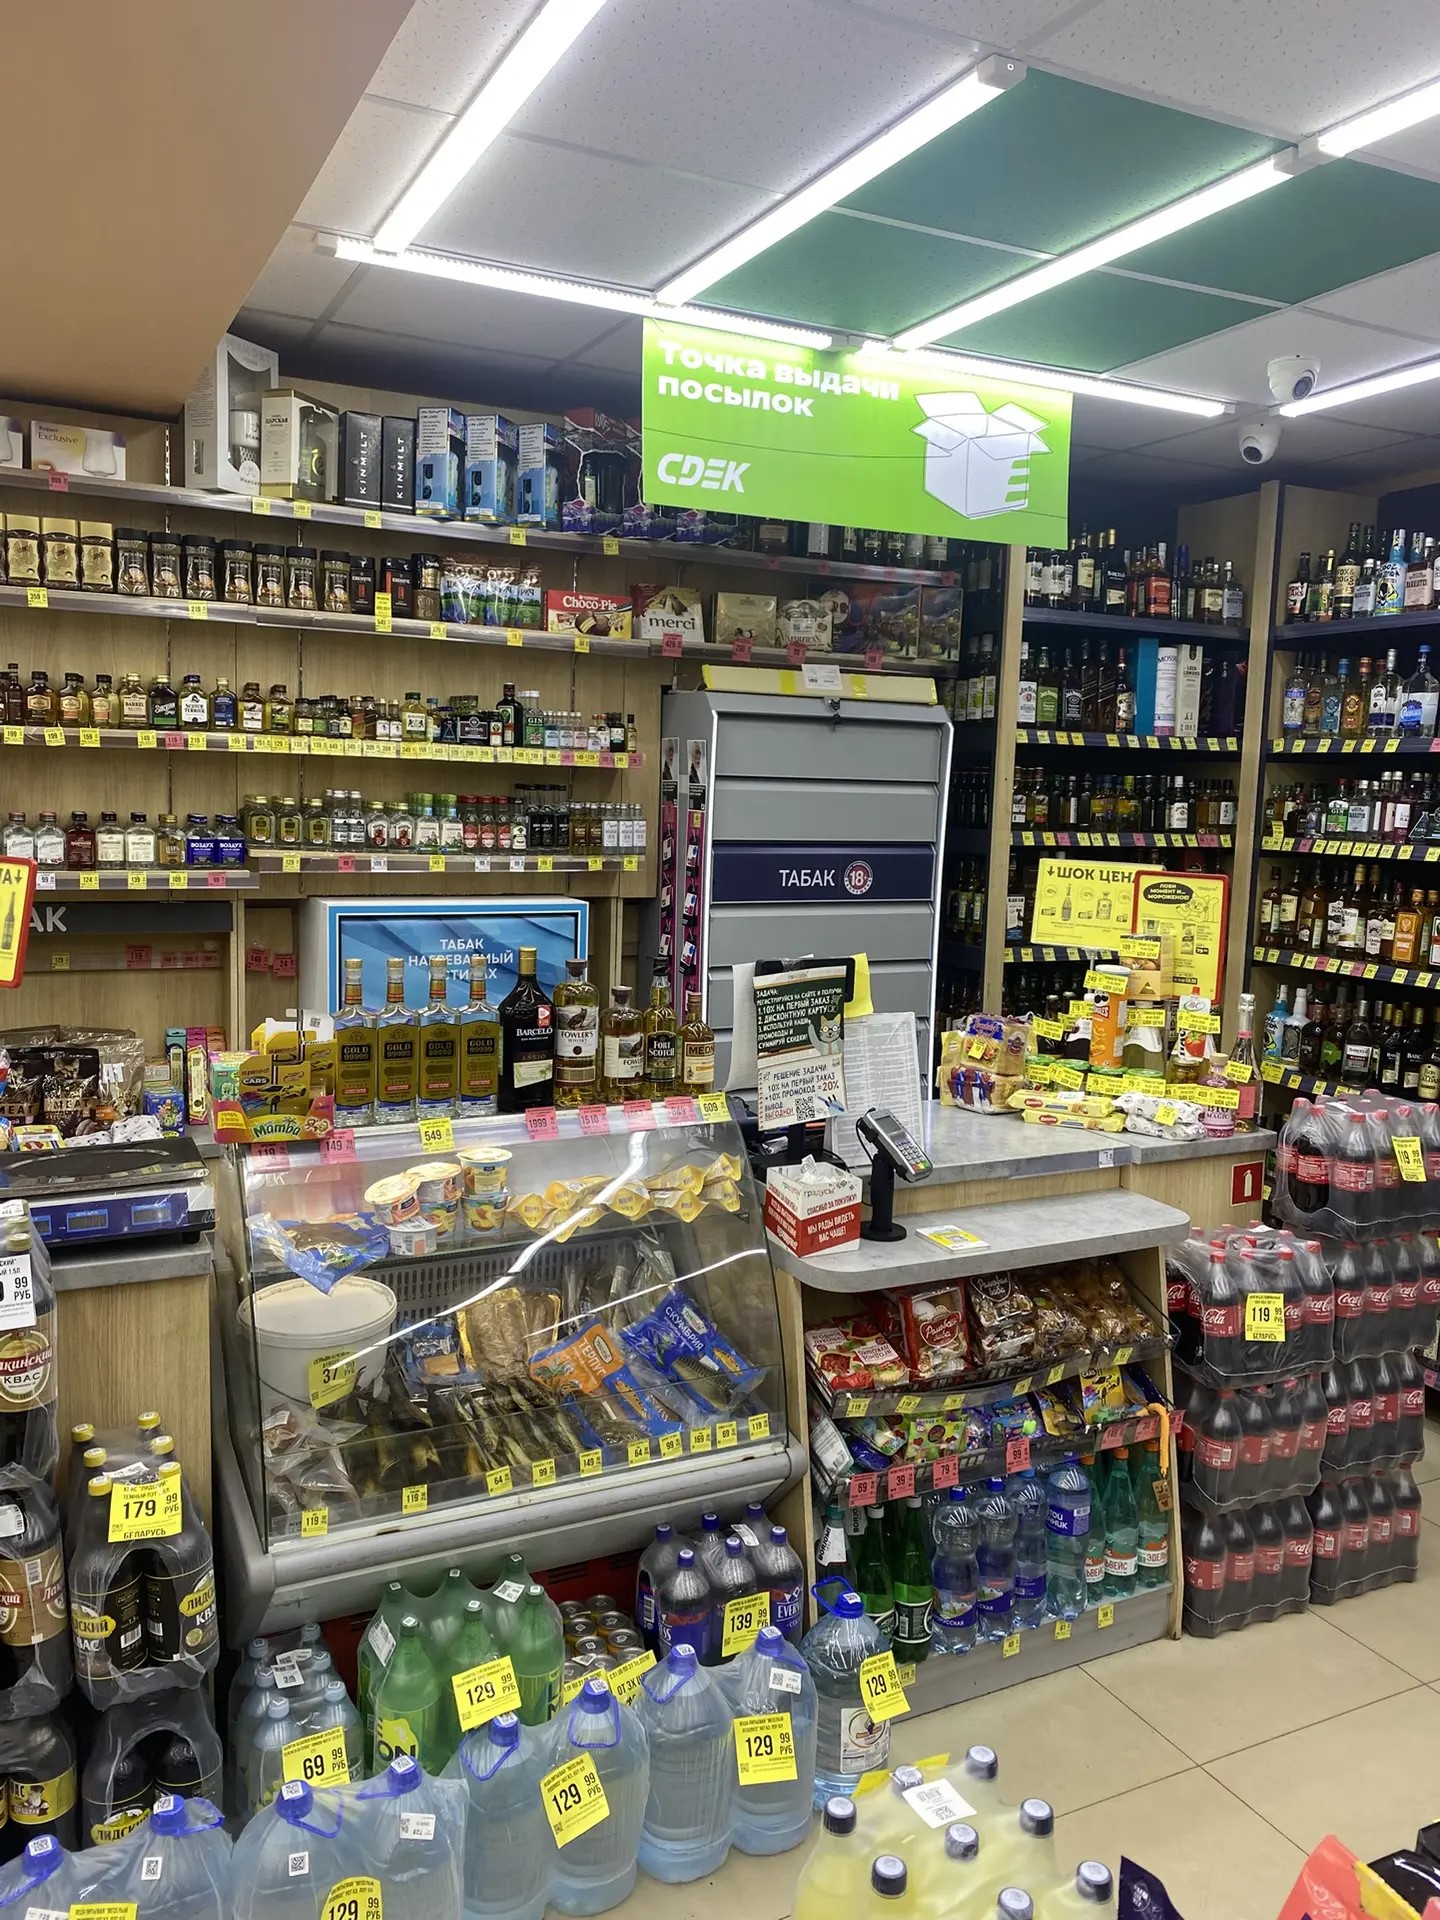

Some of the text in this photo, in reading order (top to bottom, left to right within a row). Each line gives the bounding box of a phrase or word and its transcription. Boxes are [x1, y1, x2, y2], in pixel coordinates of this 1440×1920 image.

[658, 341, 899, 402] Точка выдачи
[658, 373, 815, 418] посылок
[265, 416, 288, 425] ЦАРСКАЯ
[38, 431, 79, 445] Exclusive
[657, 453, 751, 494] CDEK
[563, 596, 617, 610] Choco-Pie
[649, 616, 696, 630] merci
[527, 716, 543, 725] GIN
[779, 869, 836, 887] ТАБАК
[1056, 866, 1094, 880] ШОК
[41, 876, 49, 884] 99
[440, 938, 484, 950] ТАБАК
[801, 990, 816, 999] САЙТЕ
[776, 1004, 785, 1012] НА
[786, 999, 810, 1010] ПЕРВЫЙ
[811, 997, 830, 1006] ЗАКАЗ
[763, 1009, 806, 1024] ДИСКОНТНУЮ
[807, 1006, 828, 1016] КАРТУ
[516, 1027, 553, 1037] BARCELÓ
[561, 1031, 594, 1039] FOWLER'S
[758, 1030, 788, 1041] ПРОМОКОДЫ
[387, 1043, 411, 1051] GOLD
[469, 1039, 492, 1047] GOLD
[653, 1040, 671, 1049] FORT
[344, 1045, 369, 1054] GOLD
[649, 1049, 675, 1057] SCOTCH
[773, 1068, 800, 1081] РЕШЕНИЕ
[243, 1076, 267, 1085] CARS
[768, 1072, 836, 1092] 10% НА ПЕРВЫЙ ЗАКАЗ
[782, 1086, 816, 1099] ПРОМОКОД
[704, 1102, 719, 1113] 609
[528, 1118, 547, 1128] 1999
[581, 1115, 599, 1124] 1510
[252, 1122, 301, 1138] Mamba
[424, 1130, 443, 1141] 549
[325, 1139, 343, 1151] 149
[1398, 1149, 1420, 1165] 119 99
[804, 1188, 835, 1198] градусы
[806, 1204, 827, 1216] СПАСИБО
[834, 1194, 857, 1207] ПОКУПКУ!
[807, 1212, 855, 1235] МЫ РАДЫ ВИДЕТЬ
[819, 1226, 847, 1243] ВАС ЧАЩЕ!
[15, 1276, 28, 1288] 99
[14, 1288, 31, 1301] РУБ
[1252, 1307, 1282, 1322] 119 99
[665, 1306, 704, 1351] СКУМБРИЯ
[1253, 1332, 1277, 1341] БЕЛАРУСЬ
[579, 1338, 607, 1376] ТЕРПУГ
[4, 1371, 41, 1384] КВАС
[1327, 1407, 1346, 1423] Cola
[751, 1421, 763, 1430] 119
[694, 1434, 706, 1444] 169
[722, 1429, 730, 1438] 69
[666, 1441, 675, 1450] 99
[634, 1448, 643, 1457] 64
[1012, 1449, 1022, 1460] 99
[583, 1457, 594, 1467] 149
[539, 1467, 548, 1477] 99
[940, 1464, 950, 1475] 79
[493, 1476, 503, 1485] 64
[896, 1475, 906, 1486] 39
[857, 1482, 868, 1493] 69
[406, 1494, 419, 1503] 119
[123, 1493, 178, 1519] 179 99
[164, 1503, 180, 1514] РУБ
[305, 1516, 319, 1526] 119
[123, 1528, 166, 1539] БЕЛАРУСЬ
[818, 1527, 831, 1561] BORJOMI
[730, 1608, 767, 1632] 139 99
[757, 1618, 769, 1628] РУБ
[502, 1683, 516, 1694] РУБ
[617, 1679, 637, 1696] ОТ 3Х
[866, 1669, 897, 1698] 129 99
[465, 1681, 495, 1706] 129
[501, 1673, 512, 1684] 99
[745, 1732, 790, 1758] 129 99
[779, 1744, 793, 1755] РУБ
[303, 1747, 343, 1780] 69 99
[332, 1760, 346, 1772] РУБ
[551, 1772, 596, 1815] 129 99
[587, 1784, 602, 1798] РУБ
[328, 1897, 379, 1920] 129 99
[366, 1909, 381, 1920] РУБ
